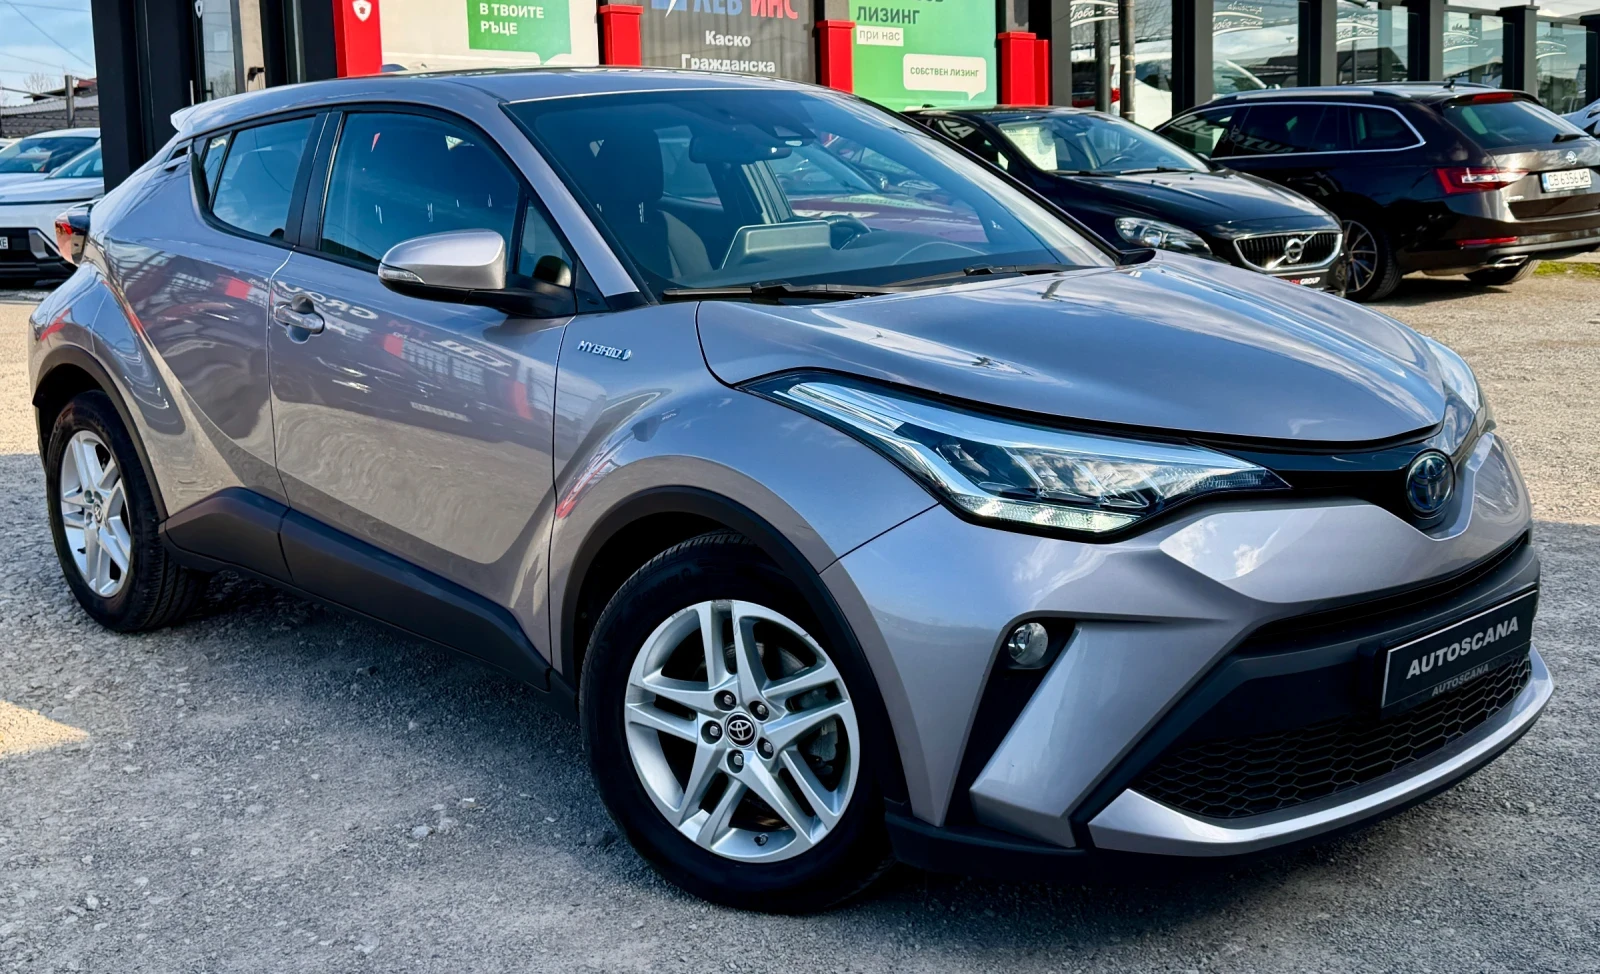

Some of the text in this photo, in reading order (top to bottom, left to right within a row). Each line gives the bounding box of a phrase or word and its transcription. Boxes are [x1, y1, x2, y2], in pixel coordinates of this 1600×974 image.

[479, 2, 545, 19] В ТВОИТЕ
[856, 6, 920, 25] ЛИЗИНГ
[480, 20, 518, 36] РЪЦЕ
[859, 29, 900, 42] при нас
[705, 29, 751, 47] Каско
[681, 53, 776, 73] Гражданска
[910, 66, 980, 78] СОБСТВЕН ЛИЗИНГ
[577, 340, 622, 359] HYBRID
[1406, 616, 1519, 680] AUTOSCANA
[1431, 663, 1490, 697] AUTOSCANA
